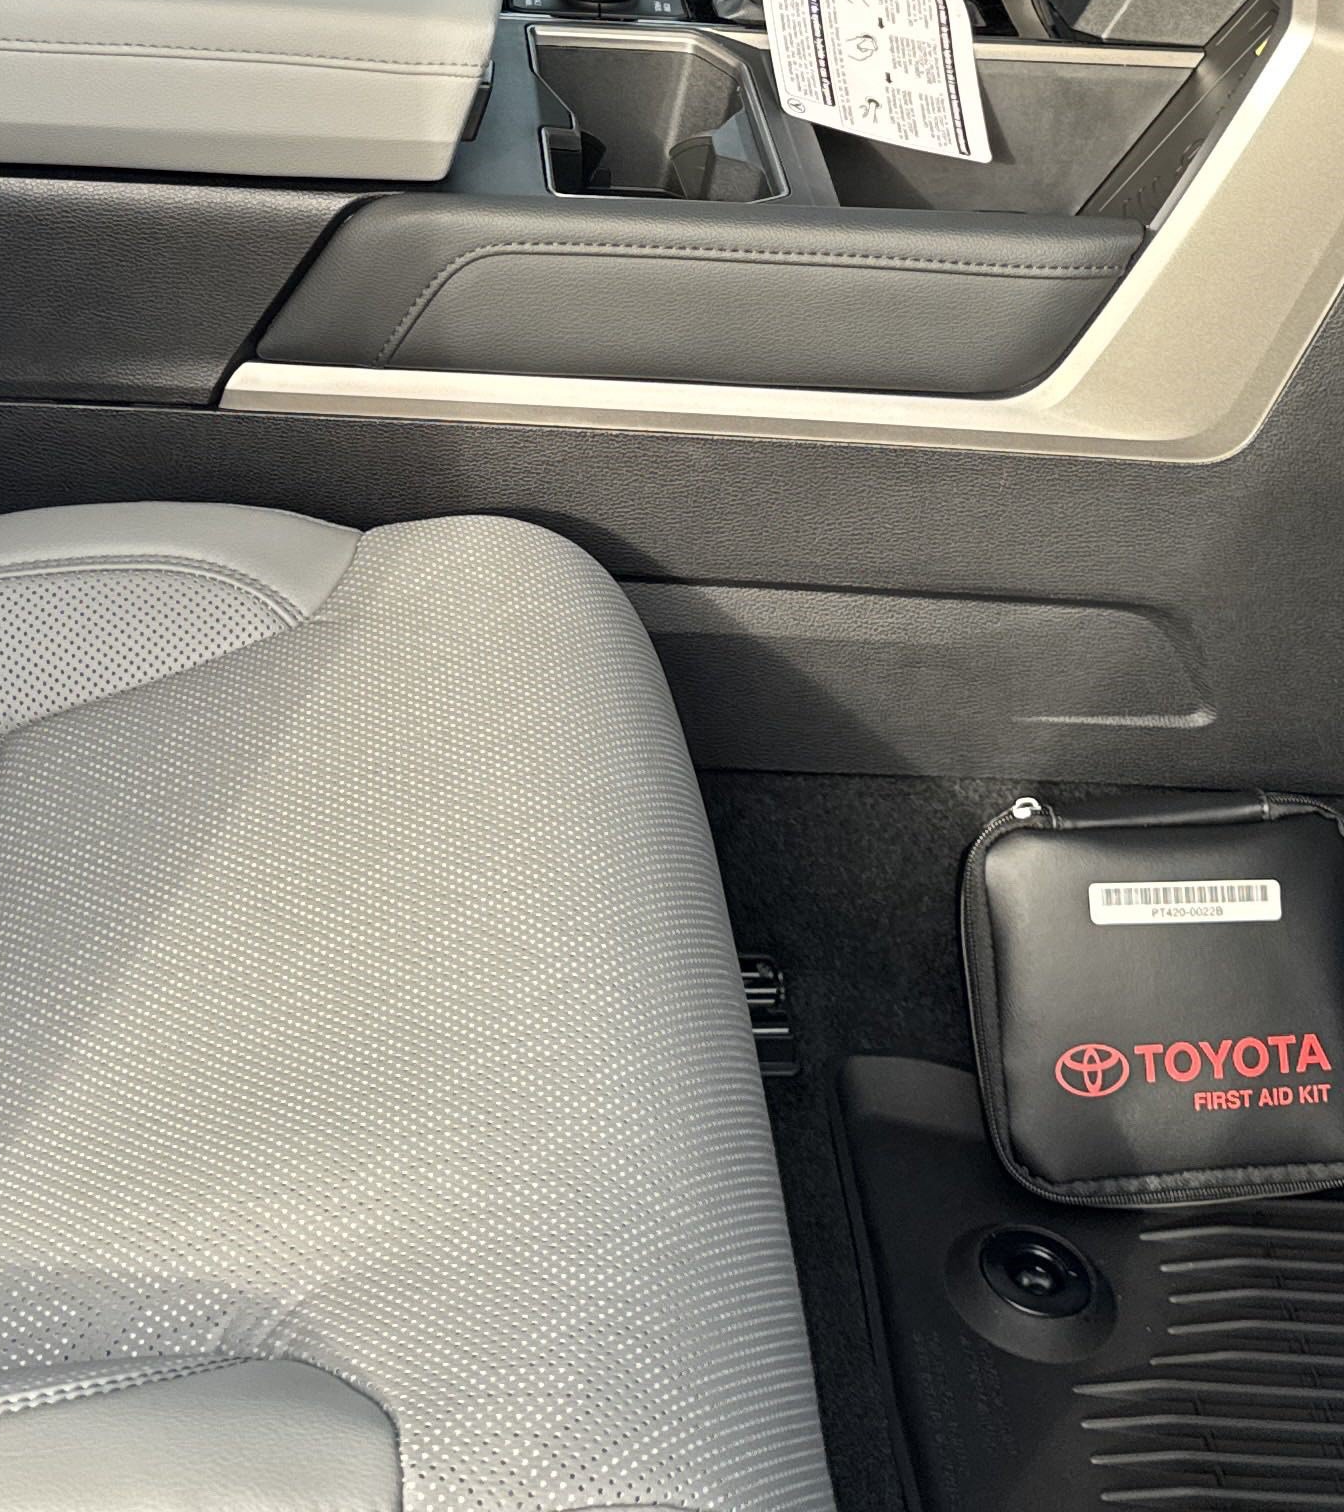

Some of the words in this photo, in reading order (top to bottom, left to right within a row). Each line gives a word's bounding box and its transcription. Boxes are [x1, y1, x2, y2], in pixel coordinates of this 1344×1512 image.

[1133, 1033, 1332, 1083] TOYOTA
[1193, 1089, 1253, 1112] FIRST
[1258, 1086, 1294, 1107] AID
[1298, 1084, 1332, 1104] KIT
